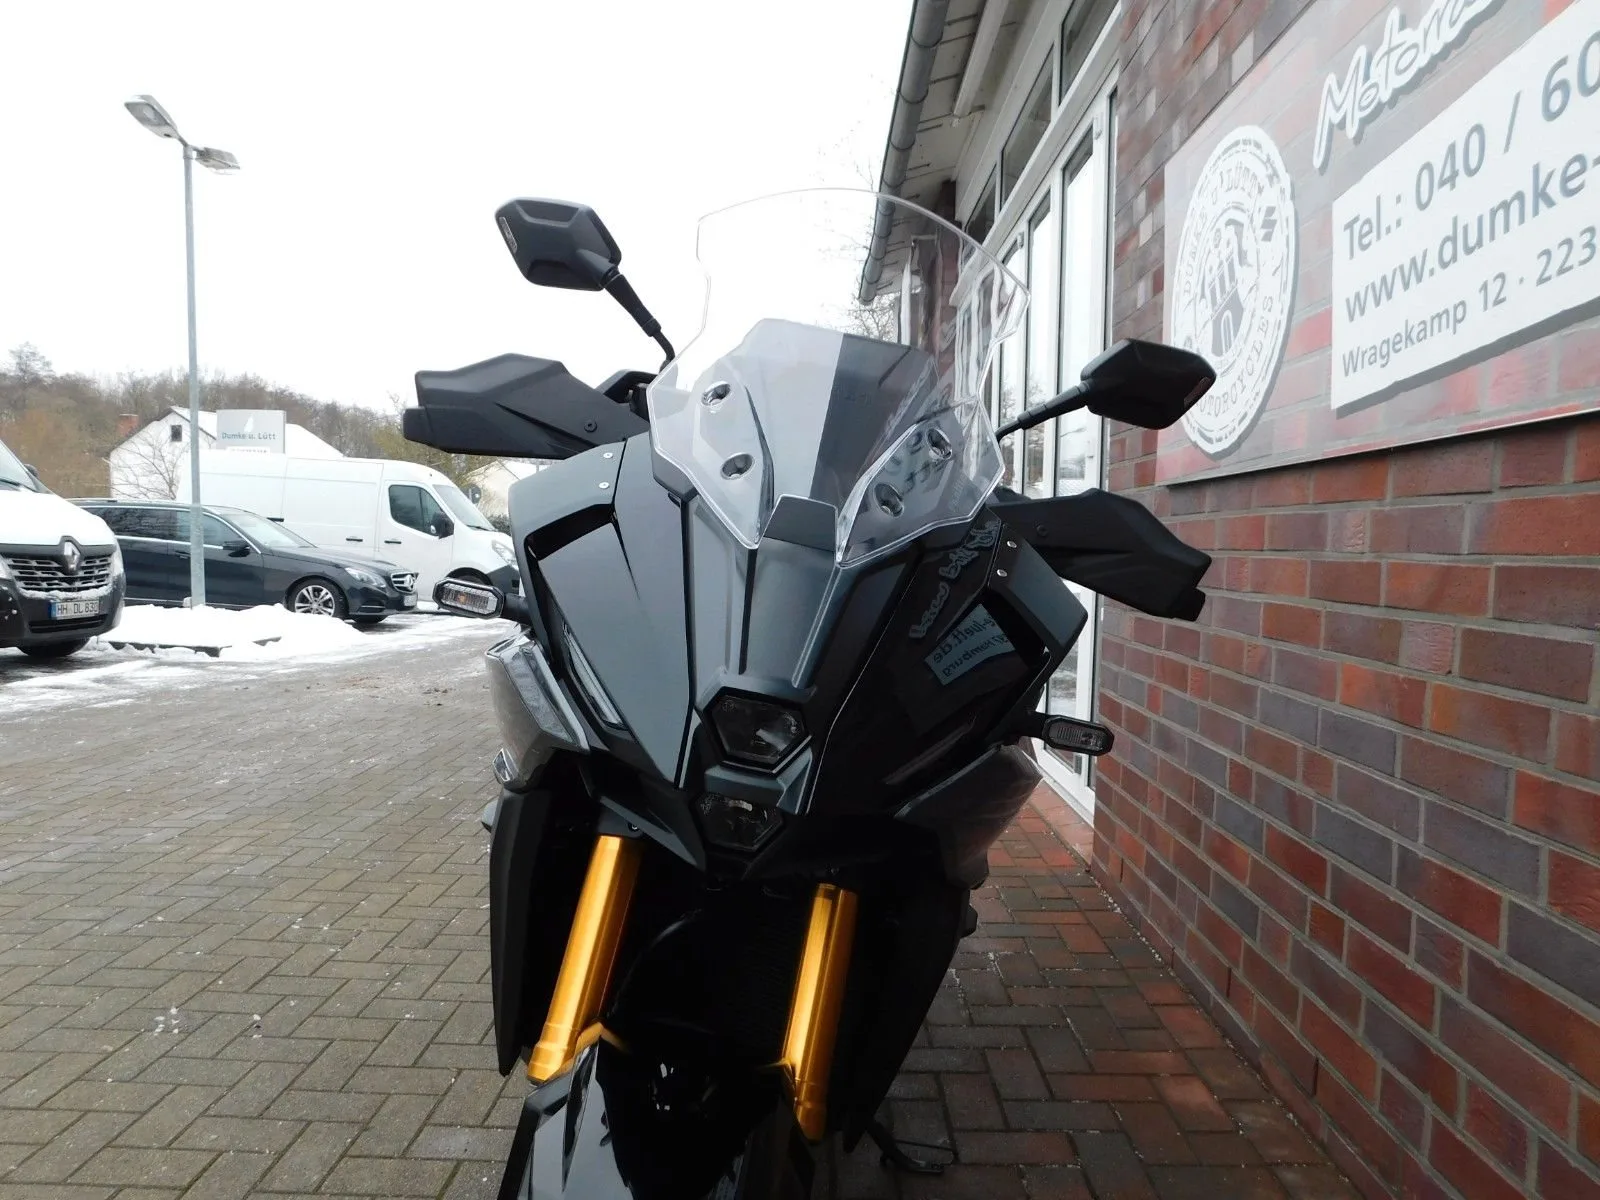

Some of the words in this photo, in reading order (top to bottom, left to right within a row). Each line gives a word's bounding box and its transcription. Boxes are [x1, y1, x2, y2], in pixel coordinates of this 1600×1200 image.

[1343, 194, 1402, 261] Tel.:
[1415, 122, 1486, 212] 040
[1197, 295, 1275, 418] OTORCYCLES
[1342, 300, 1467, 378] Wragekamp
[1478, 271, 1508, 312] 12
[1535, 225, 1597, 287] 223
[221, 432, 246, 440] Dumke
